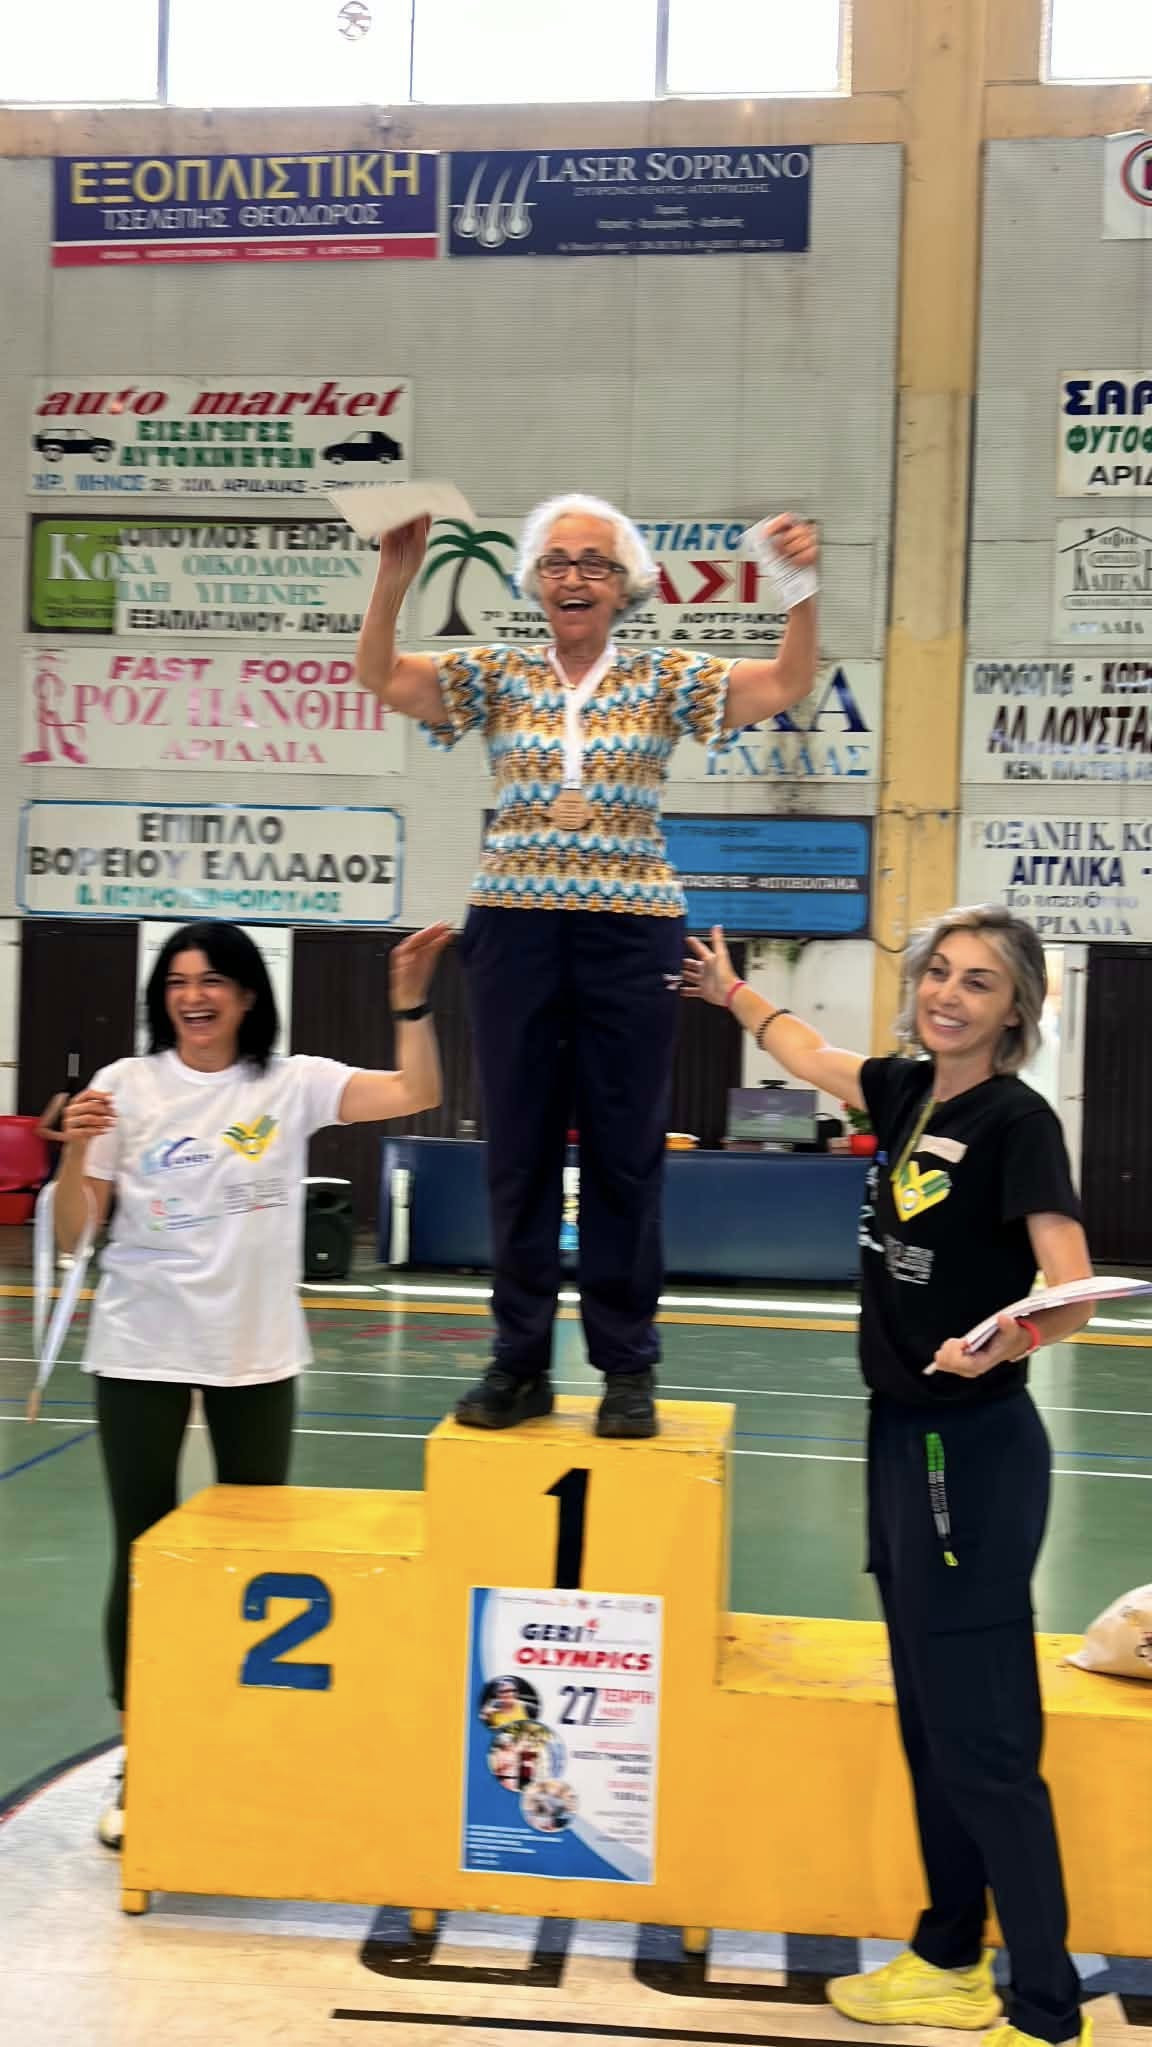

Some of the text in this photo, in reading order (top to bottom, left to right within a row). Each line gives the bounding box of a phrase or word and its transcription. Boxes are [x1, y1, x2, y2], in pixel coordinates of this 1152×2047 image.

[71, 154, 420, 204] ΕΞΟΠΛΙΣΤΙΚΗ
[536, 153, 809, 183] LASER SOPRANO
[239, 204, 384, 228] ΘΕΟΔΩΡΟΣ
[37, 382, 407, 416] auto market
[110, 655, 356, 684] FAST FOOD
[72, 685, 168, 726] ΡΟΖ
[1038, 705, 1152, 754] ΛΟΥΣΤΑ
[160, 739, 328, 764] ΑΡΙΔΑΙΑ
[139, 813, 283, 844] ΕΠΙΠΛΟ
[28, 847, 394, 884] ΒΟΡΕΙΟΥ ΕΛΛΑΔΟΣ
[1010, 855, 1125, 886] ΑΓΓΛΙΚΑ
[543, 1468, 591, 1589] 1
[240, 1572, 334, 1690] 2
[515, 1646, 652, 1671] OLYMPICS
[559, 1685, 598, 1726] 27
